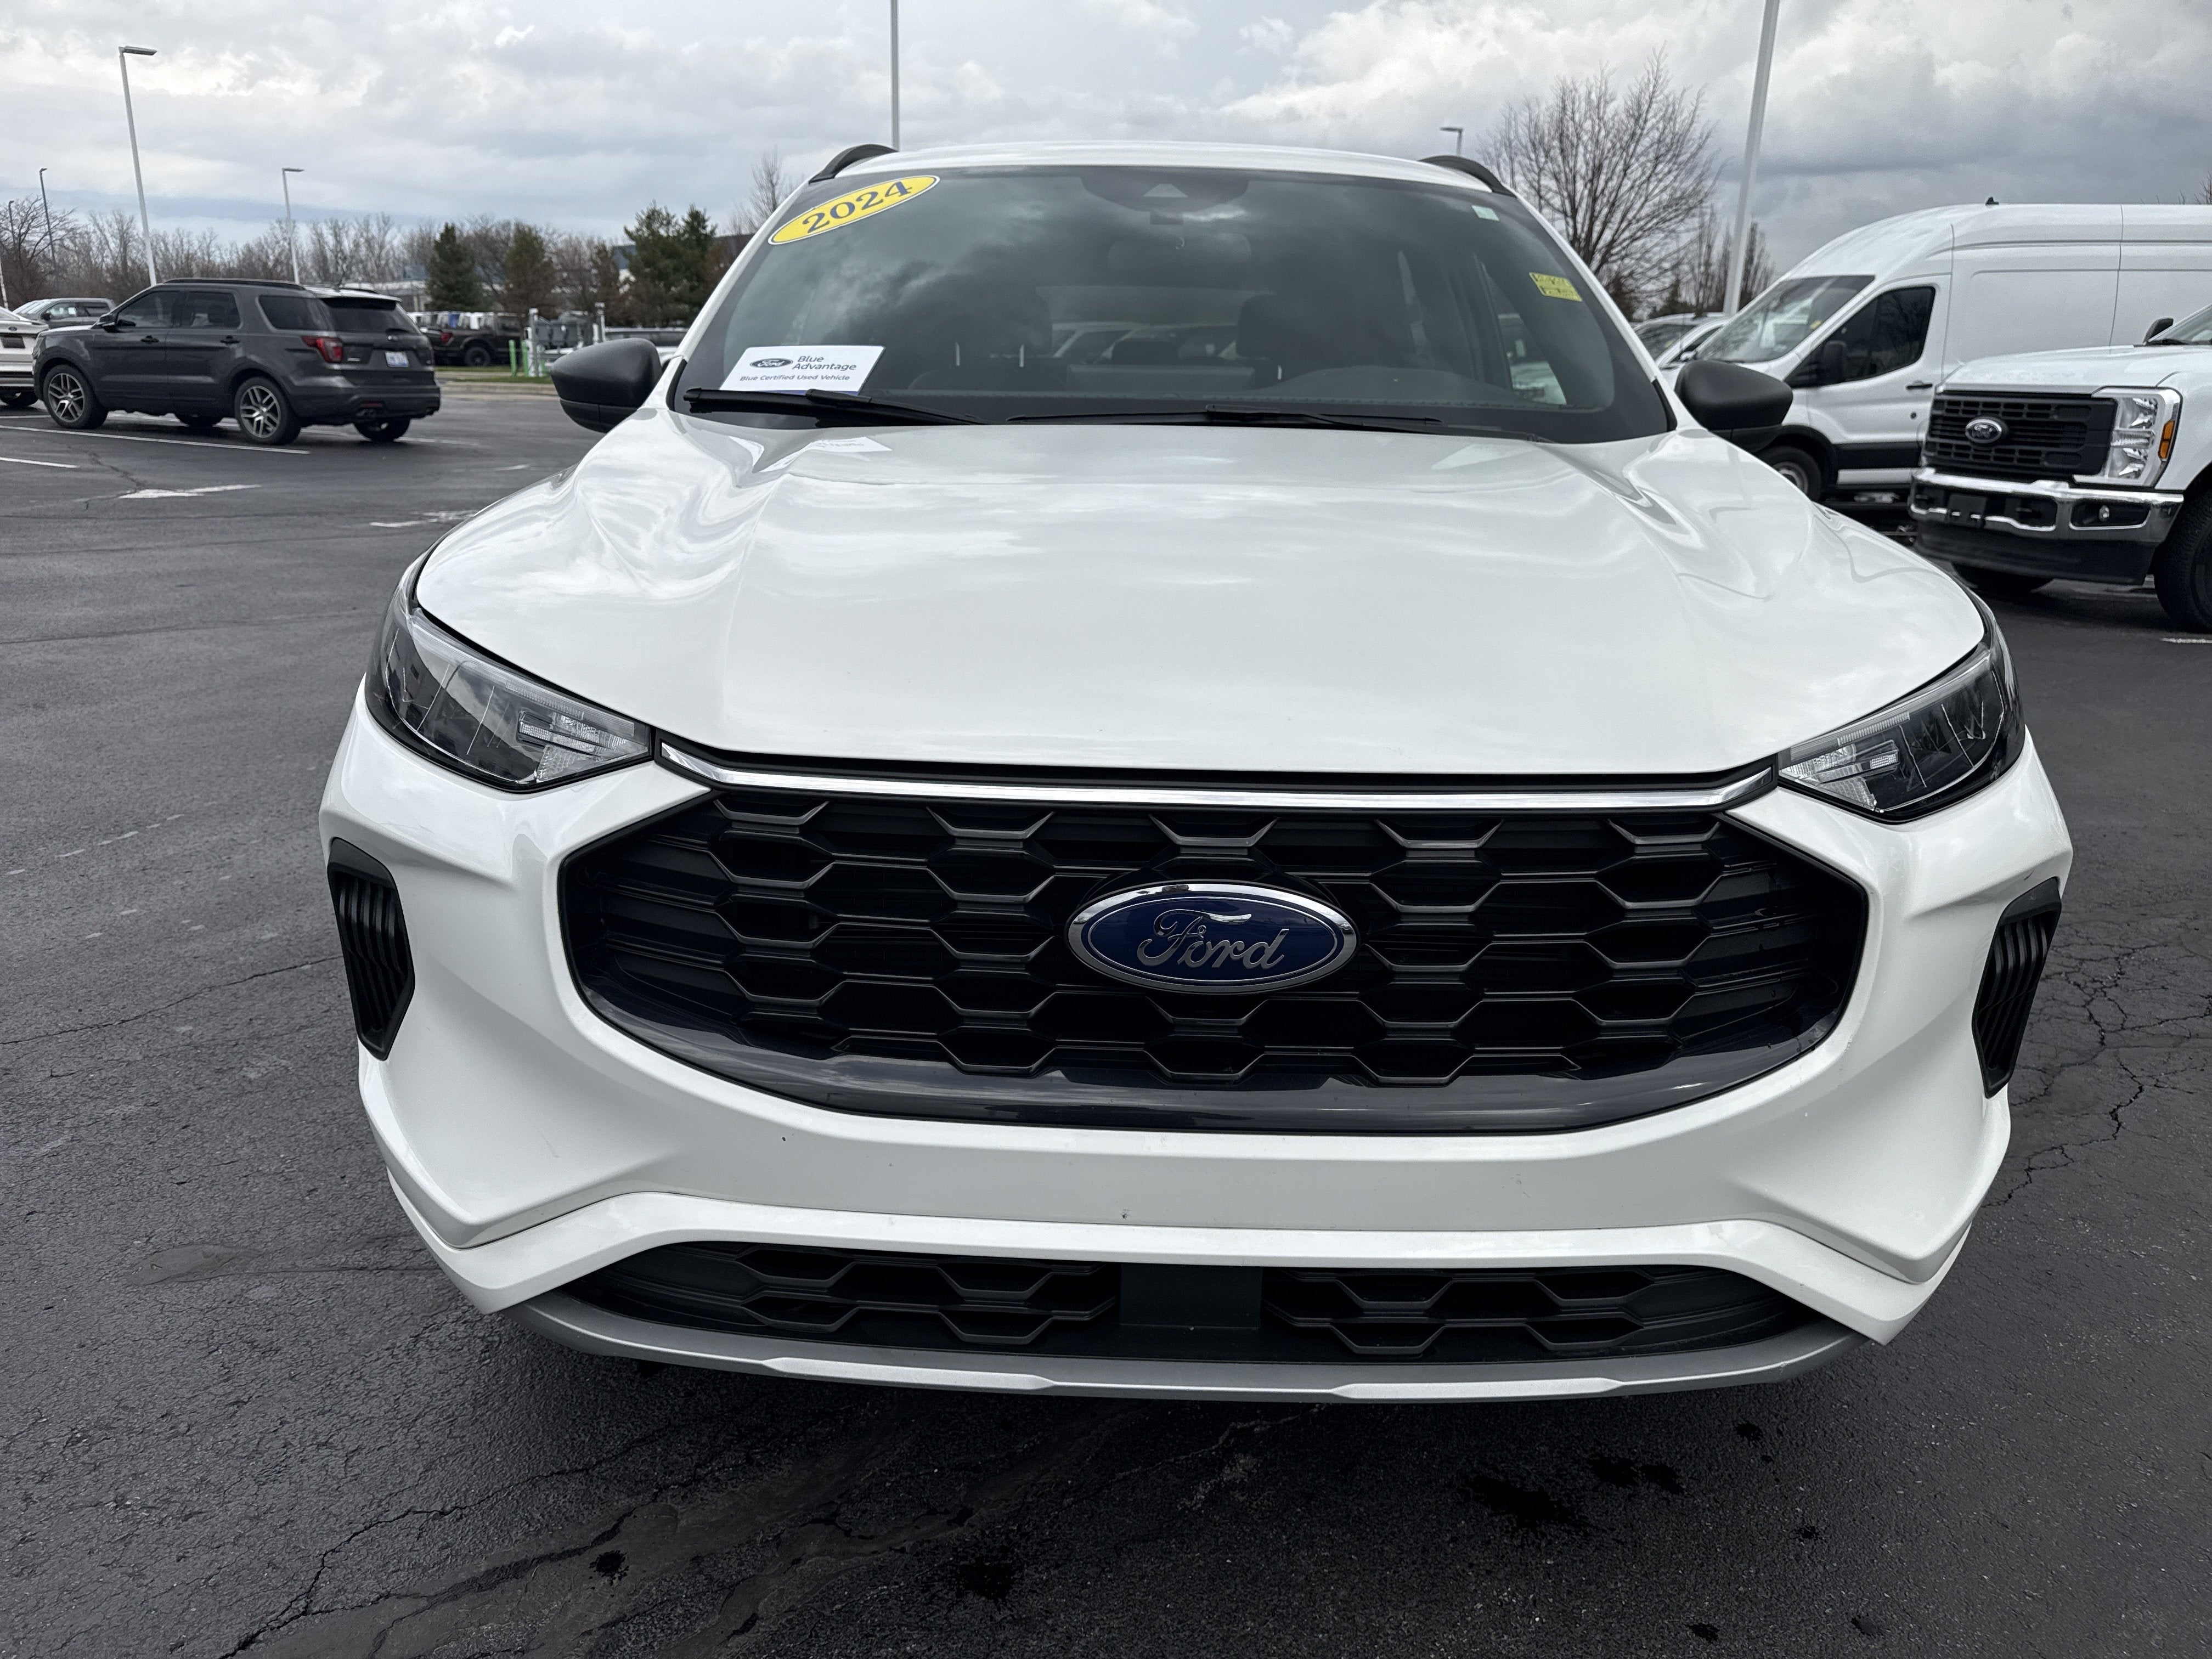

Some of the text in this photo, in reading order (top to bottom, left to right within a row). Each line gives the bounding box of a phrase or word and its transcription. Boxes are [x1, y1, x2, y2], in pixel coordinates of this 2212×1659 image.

[802, 181, 913, 233] 2024
[757, 359, 785, 368] Ford
[792, 363, 857, 371] Advantage
[1137, 909, 1290, 969] Ford
